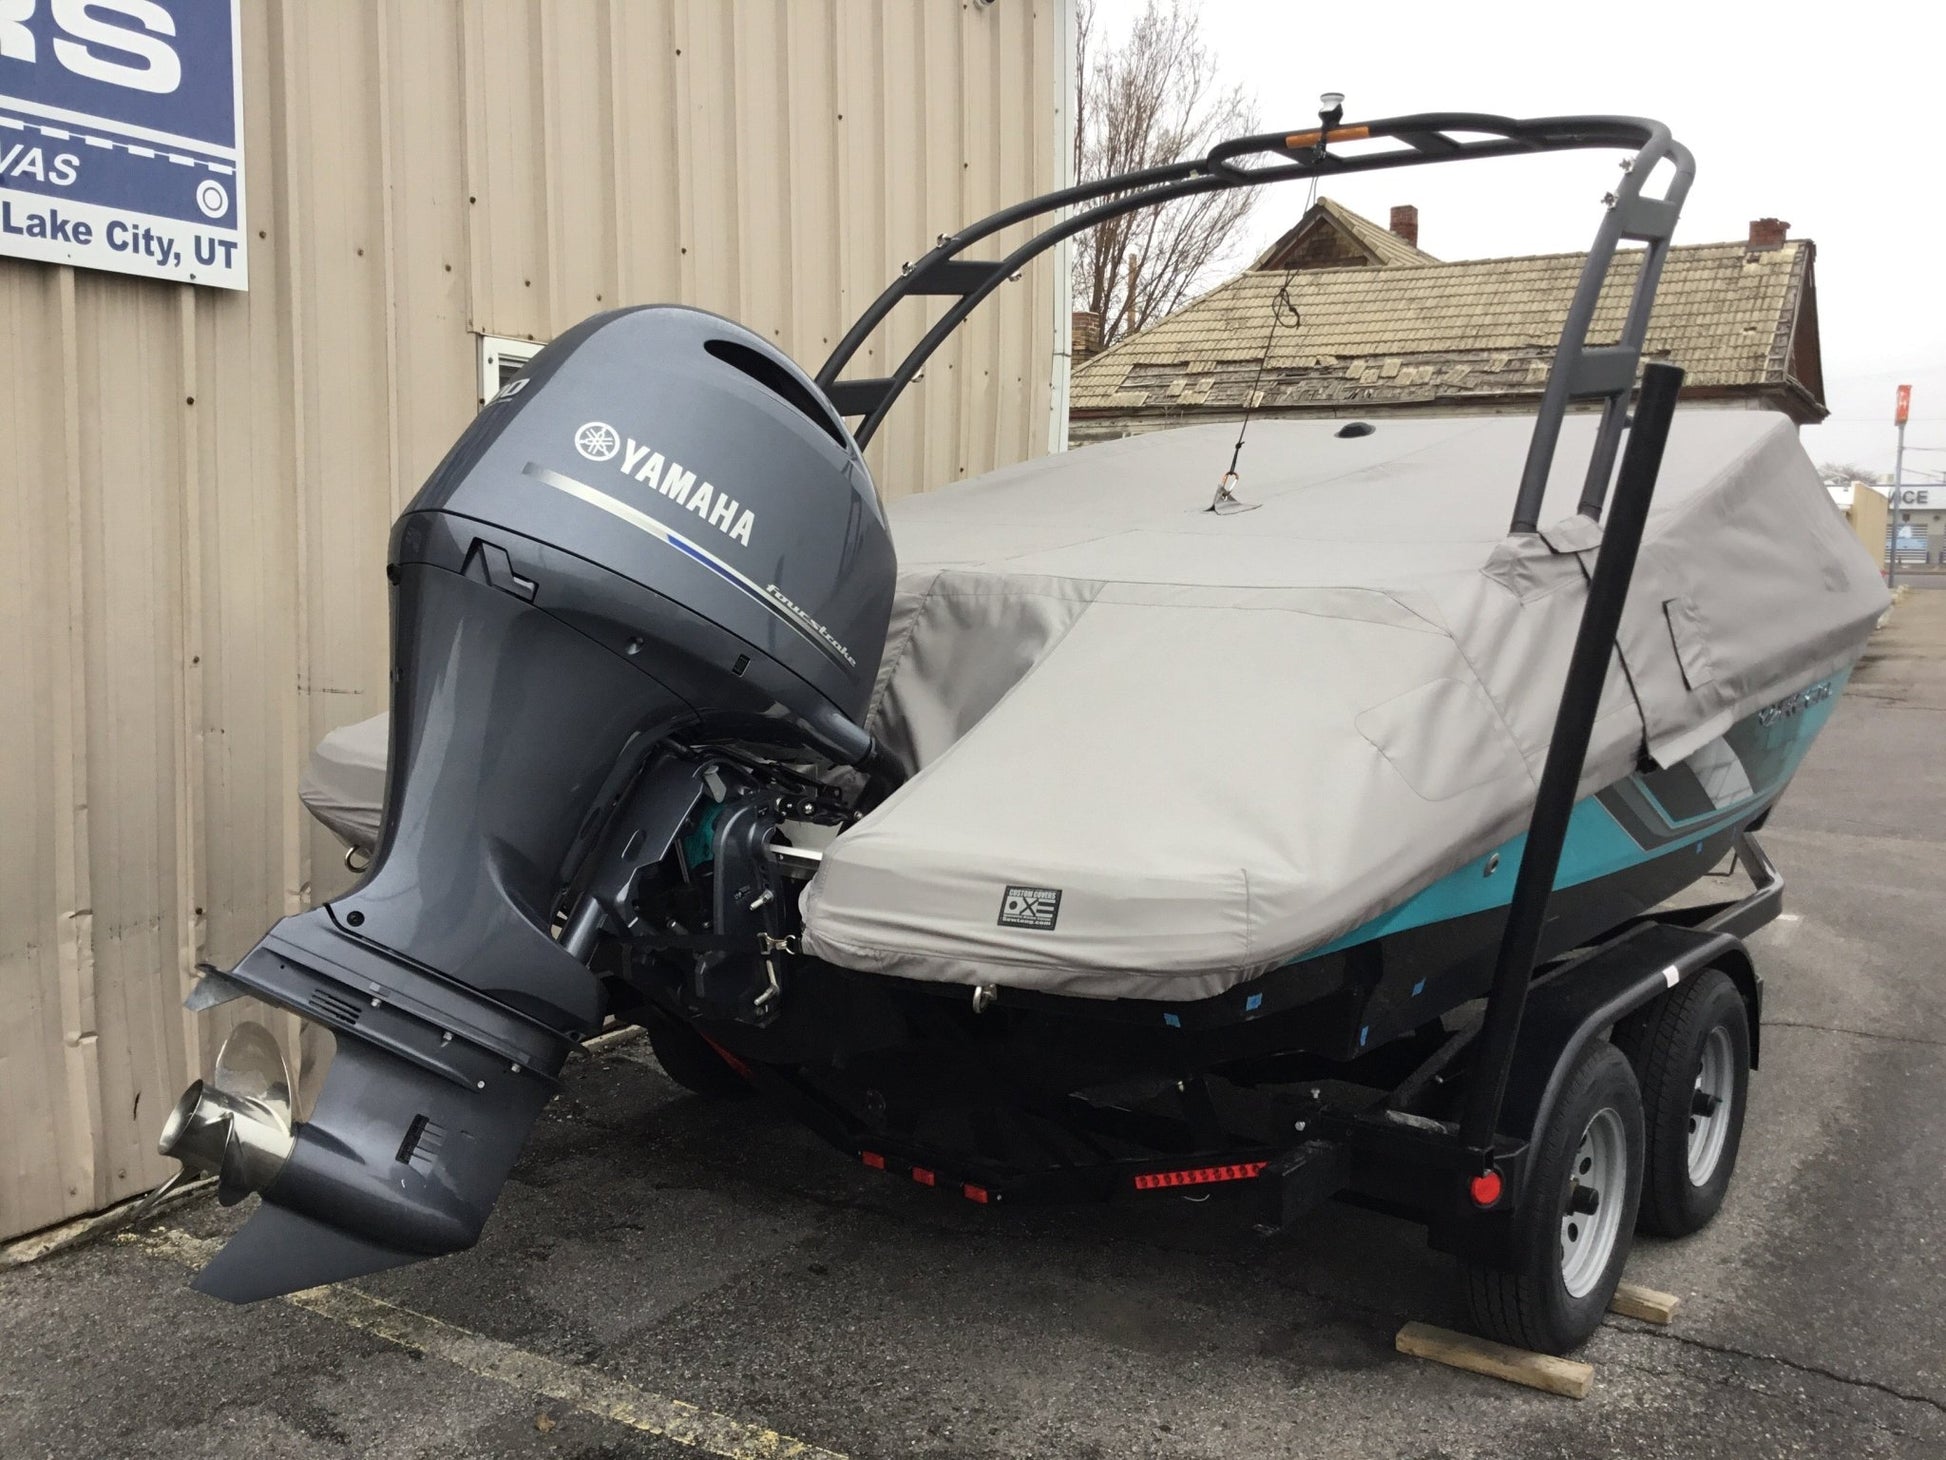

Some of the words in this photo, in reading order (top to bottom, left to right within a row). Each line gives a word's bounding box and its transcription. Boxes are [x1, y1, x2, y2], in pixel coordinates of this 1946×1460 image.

[2, 201, 93, 245] Lake
[106, 220, 181, 268] City,
[194, 235, 238, 269] UT
[620, 438, 756, 547] YAMAHA
[766, 584, 856, 667] fourstroke
